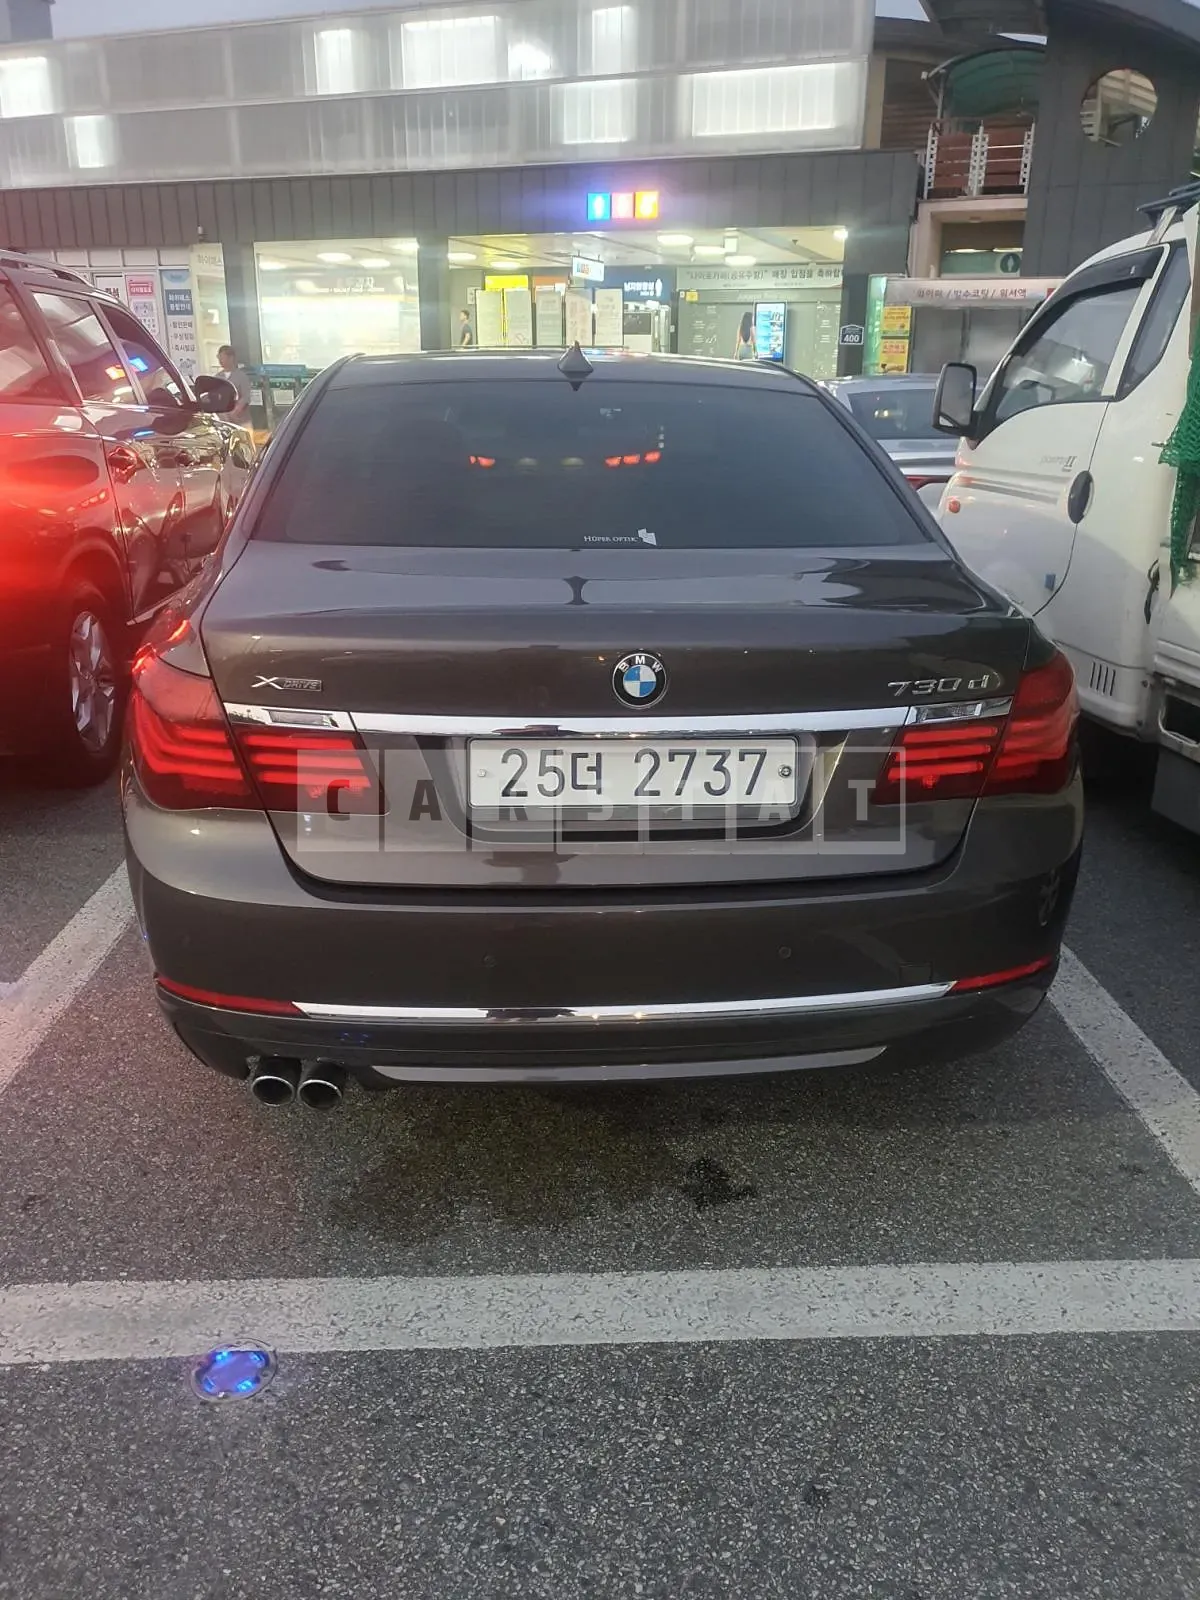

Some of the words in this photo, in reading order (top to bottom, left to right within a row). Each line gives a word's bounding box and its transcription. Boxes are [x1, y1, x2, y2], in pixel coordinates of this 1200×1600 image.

[772, 268, 788, 279] 매장
[843, 334, 860, 343] 400
[619, 655, 662, 672] BMW
[500, 748, 603, 798] 25더
[633, 748, 768, 797] 2737
